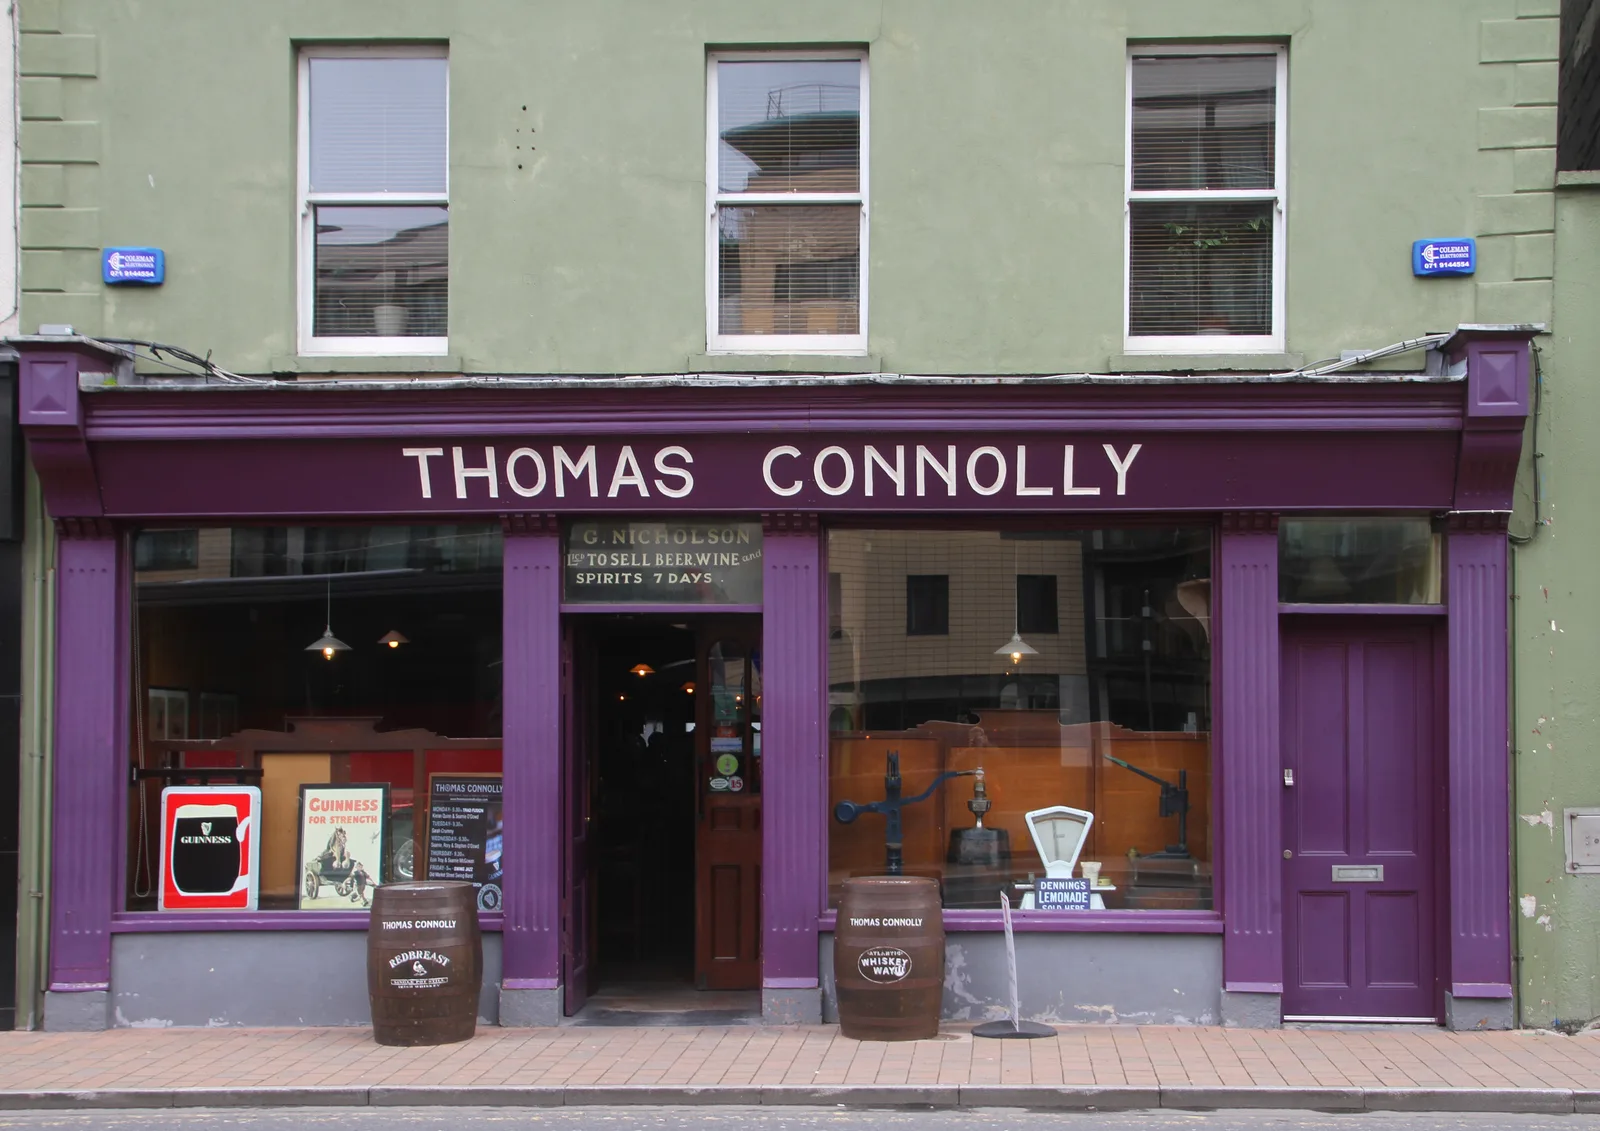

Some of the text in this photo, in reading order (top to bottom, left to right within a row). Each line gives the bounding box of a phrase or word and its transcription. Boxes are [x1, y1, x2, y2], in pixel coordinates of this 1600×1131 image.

[402, 443, 1142, 498] THOMAS CONNOLLY
[612, 529, 750, 545] NICHOLSON
[587, 553, 607, 566] TO
[610, 553, 651, 566] SELL
[742, 549, 762, 563] and
[576, 573, 643, 584] SPIRITS
[653, 573, 662, 584] 7
[436, 784, 504, 793] THOMAS CONNOLLY
[730, 779, 742, 789] 15
[308, 797, 379, 812] GUINNESS
[308, 815, 378, 824] FOR STRENGTH
[180, 836, 232, 844] GUINNESS
[1040, 881, 1086, 890] DENNING'S
[1038, 890, 1088, 904] LEMONADE
[382, 920, 456, 930] THOMAS CONNOLLY
[850, 918, 922, 926] THOMAS CONNOLLY
[388, 950, 450, 969] REDBREAST
[861, 957, 908, 967] WHISKEY
[873, 966, 895, 975] WAY
